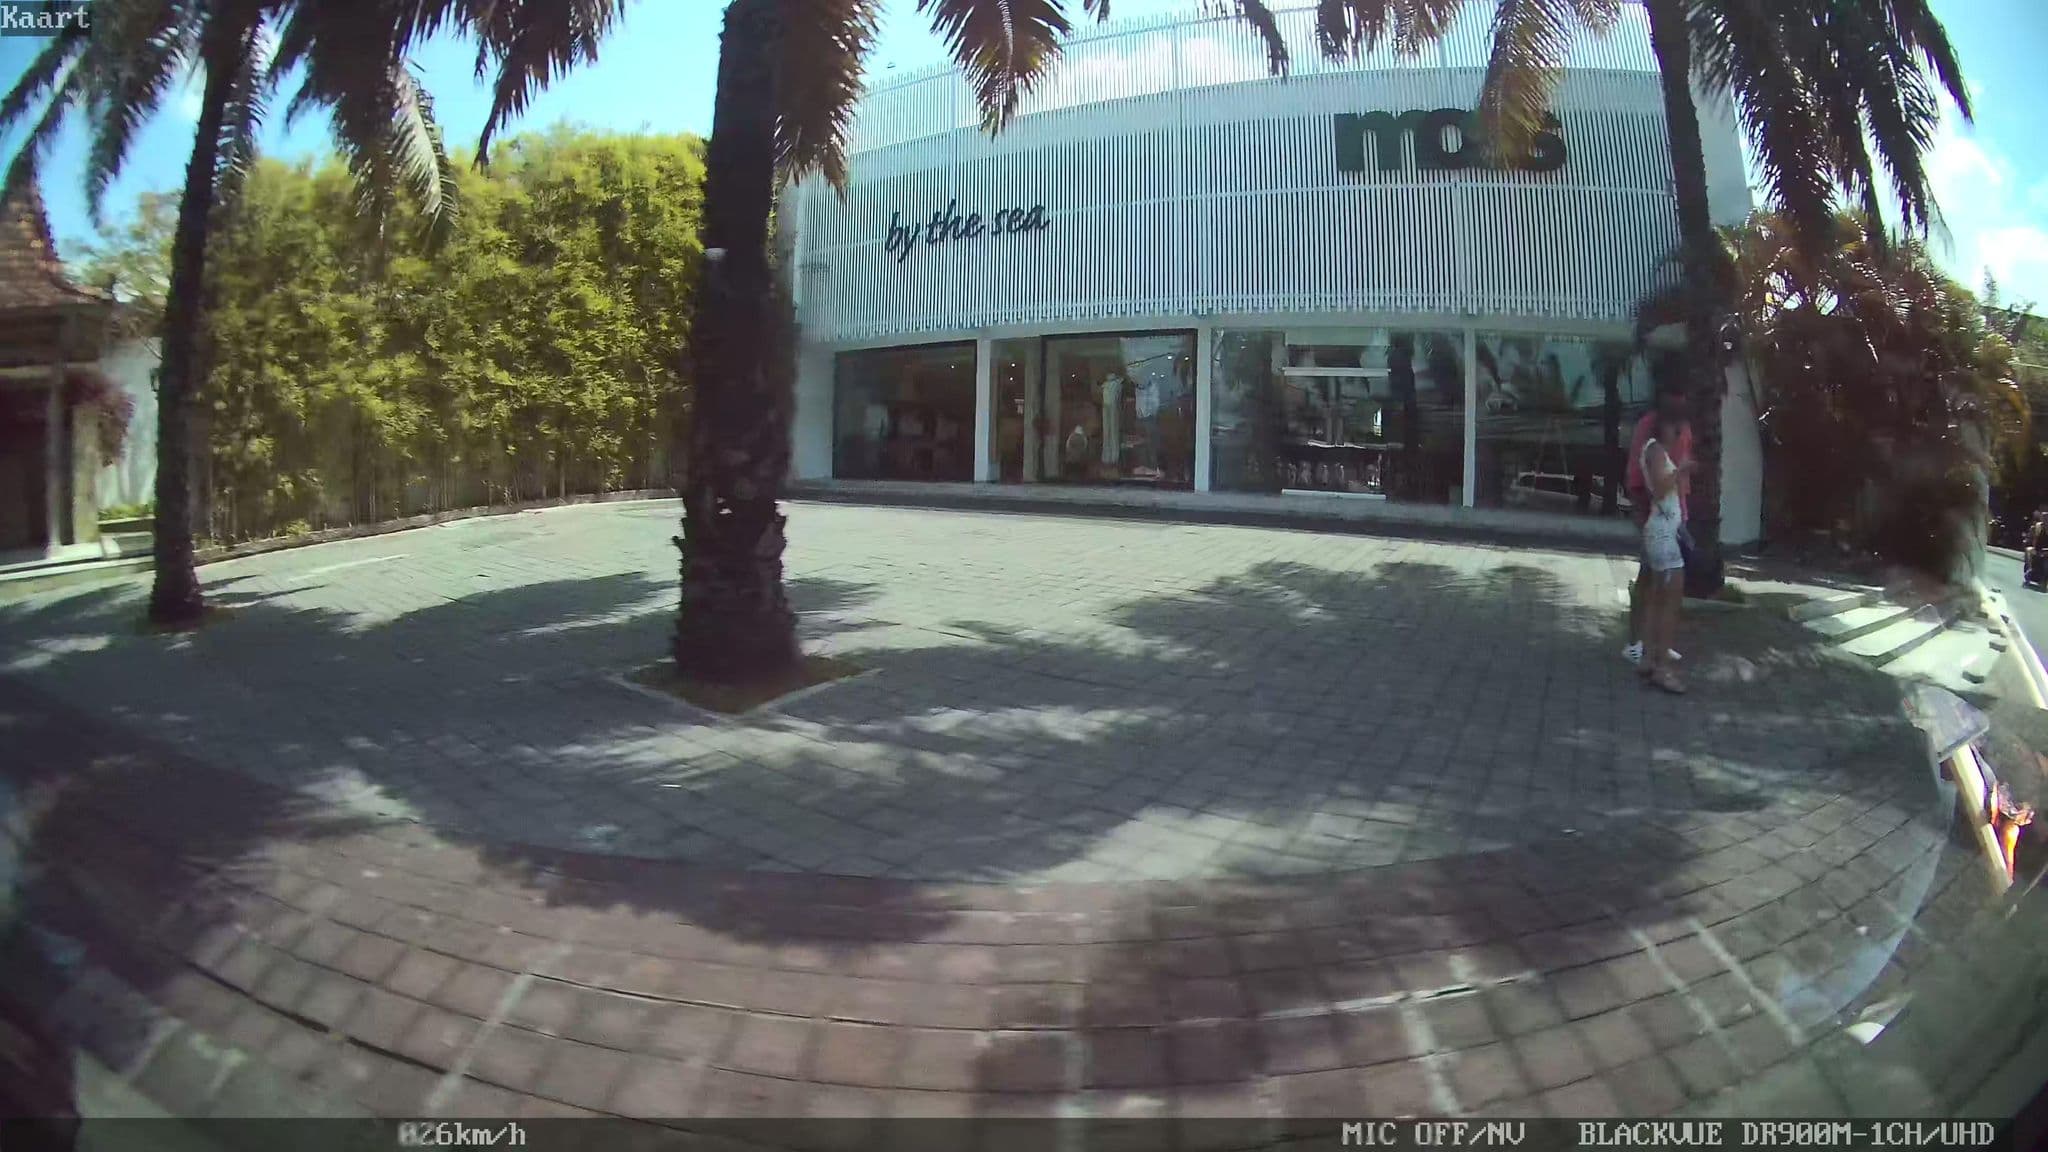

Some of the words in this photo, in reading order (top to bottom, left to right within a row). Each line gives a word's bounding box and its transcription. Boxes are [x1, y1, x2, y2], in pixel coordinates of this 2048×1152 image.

[885, 211, 921, 263] by
[926, 198, 985, 245] the
[991, 204, 1051, 236] sea
